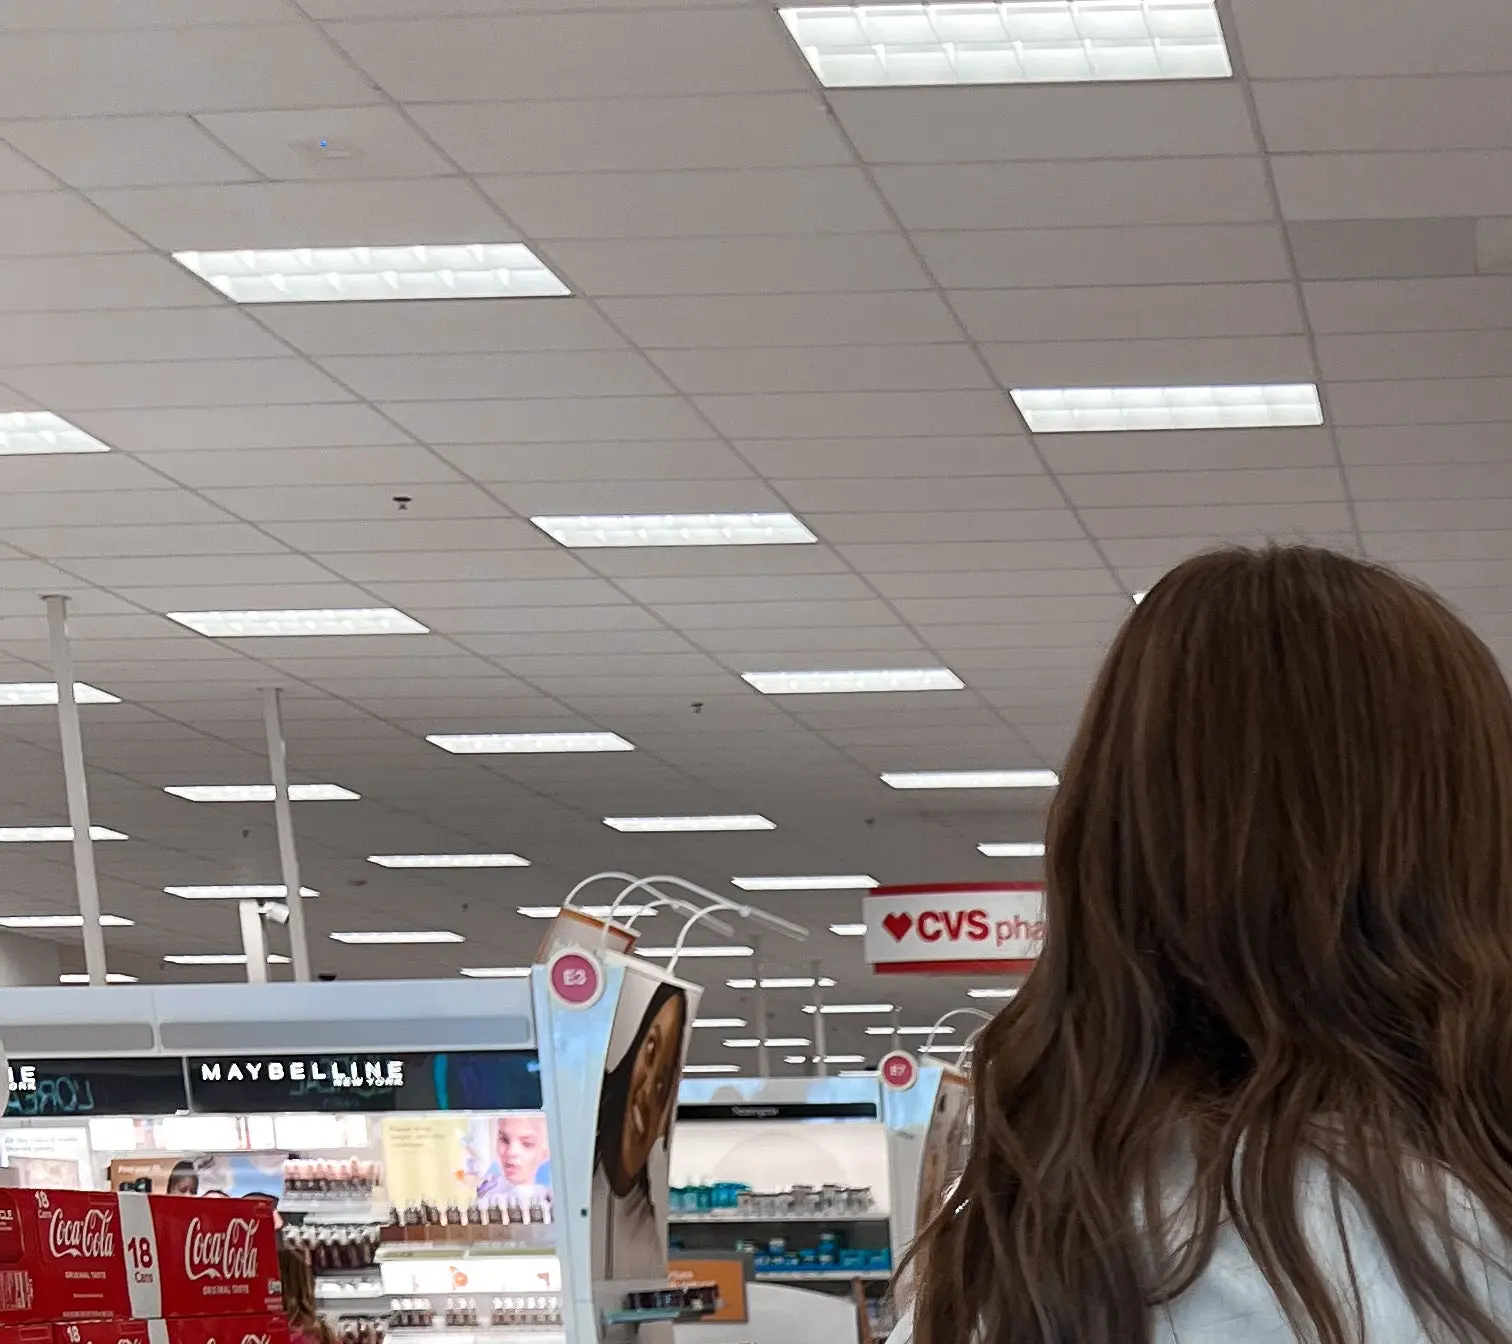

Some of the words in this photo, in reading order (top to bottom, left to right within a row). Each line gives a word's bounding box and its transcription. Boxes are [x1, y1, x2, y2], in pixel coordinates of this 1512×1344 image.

[917, 908, 989, 943] CVS
[201, 1060, 403, 1081] MAYBELLINE
[333, 1077, 363, 1087] NEW
[366, 1077, 403, 1086] YORK
[128, 1237, 153, 1269] 18
